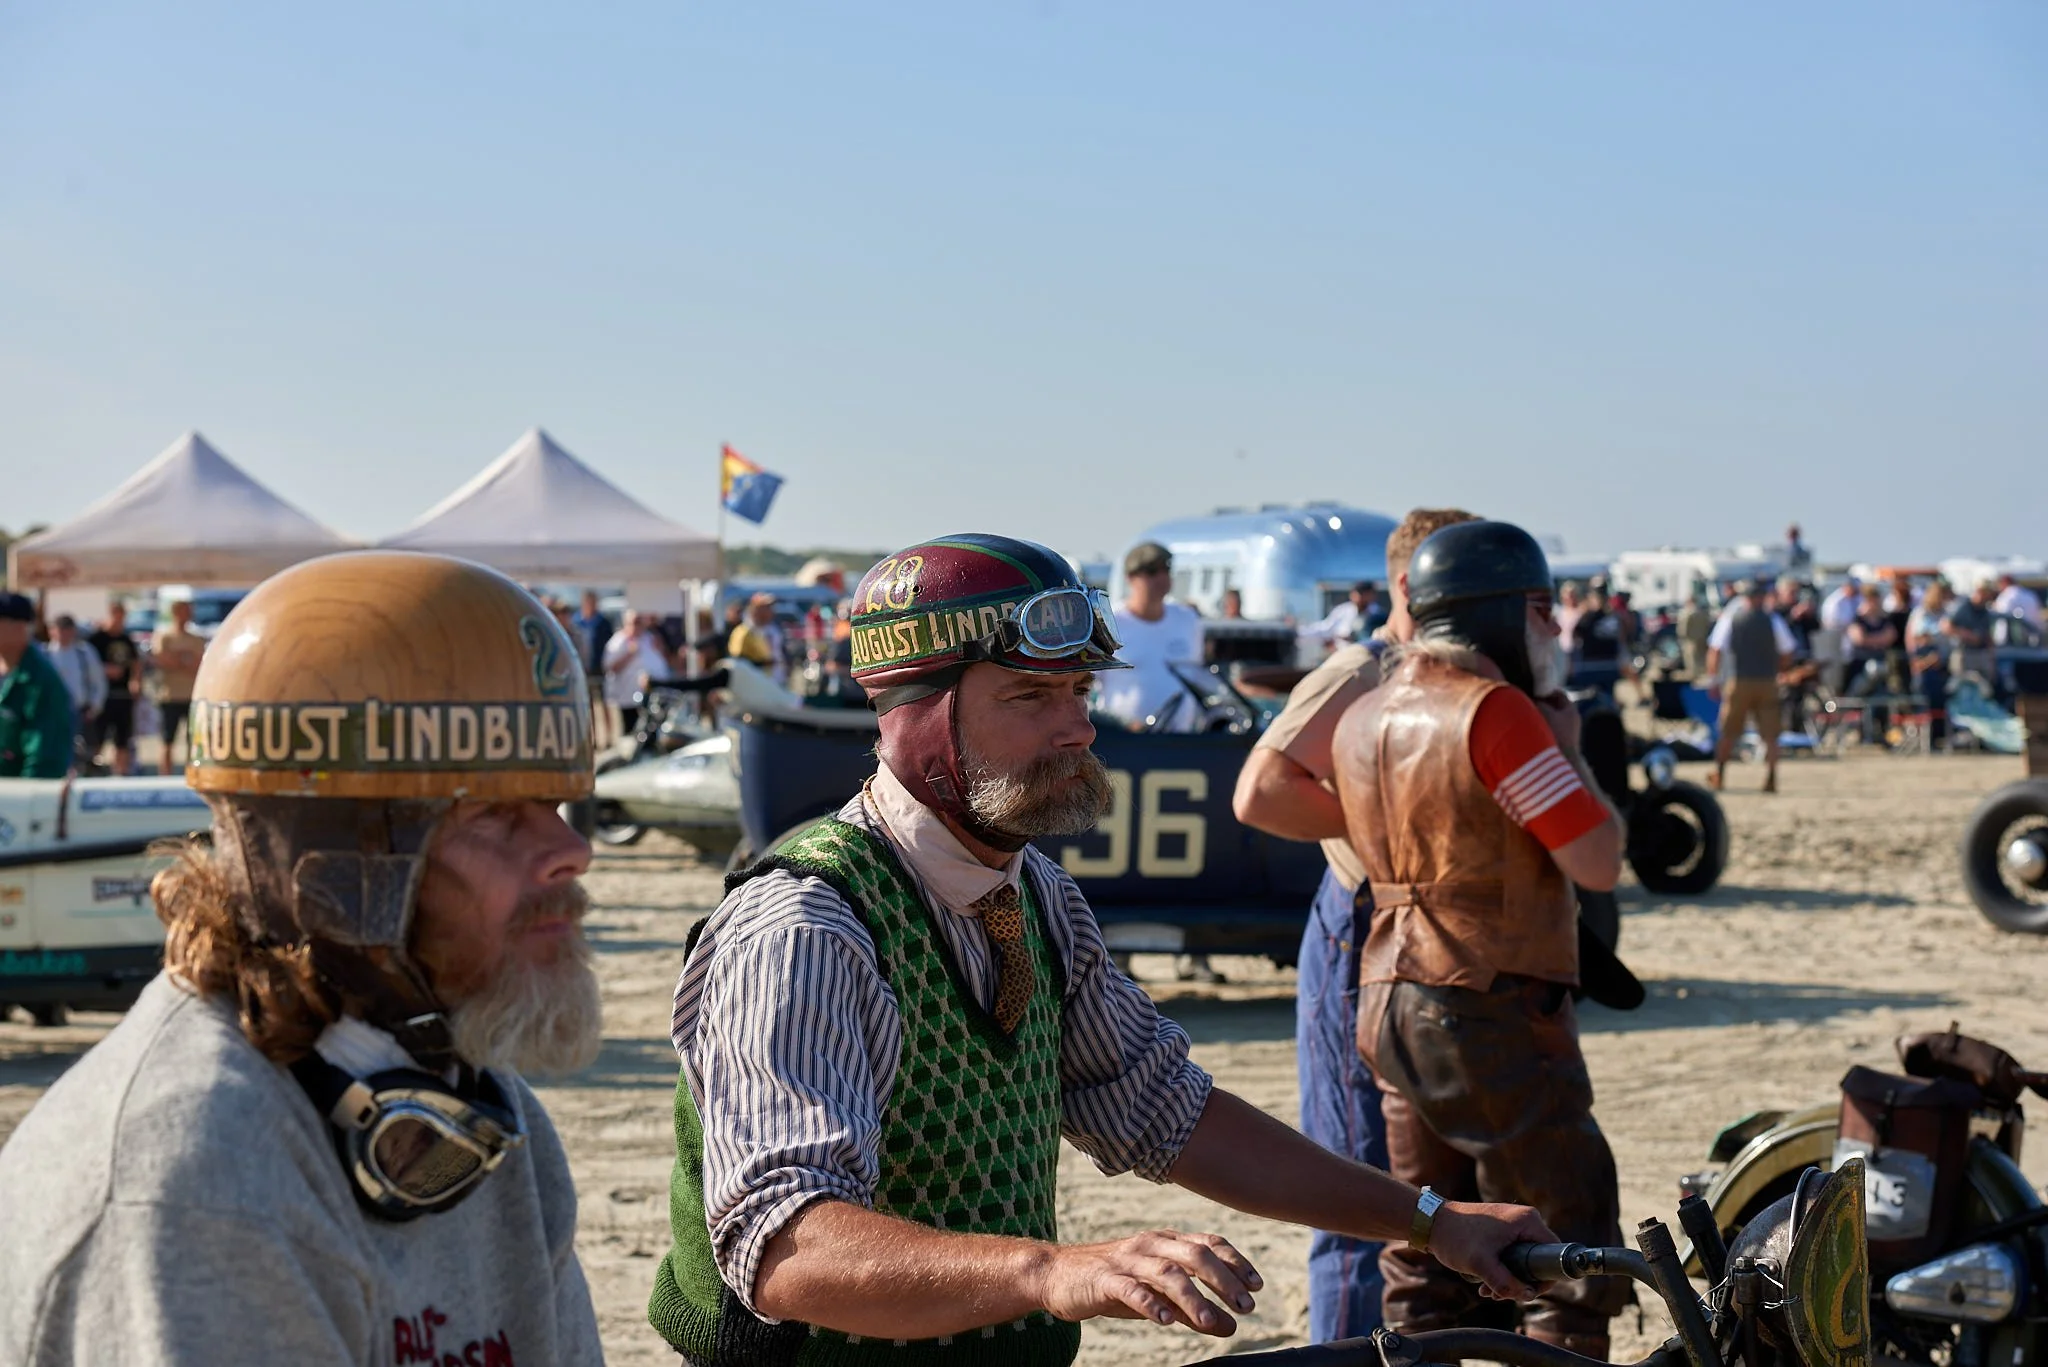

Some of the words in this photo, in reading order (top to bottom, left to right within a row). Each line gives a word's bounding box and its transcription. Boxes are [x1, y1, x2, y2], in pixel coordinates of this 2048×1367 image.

[865, 555, 925, 614] 28
[850, 619, 921, 665] AUGUST
[190, 699, 349, 762] AUGUST
[365, 698, 578, 762] LINDBLAD
[1061, 769, 1209, 879] 96
